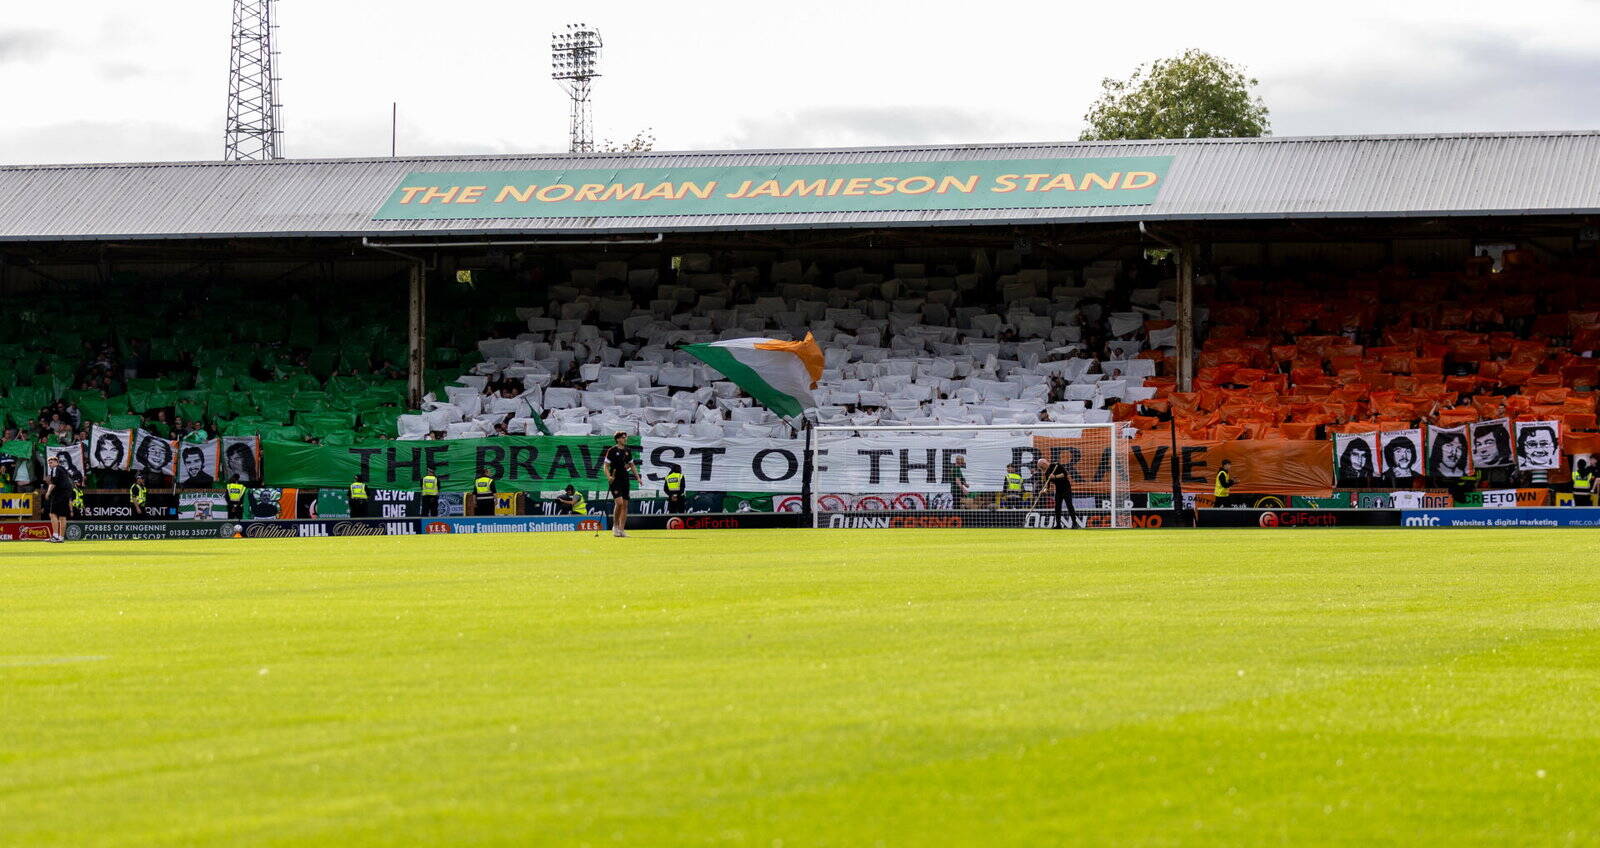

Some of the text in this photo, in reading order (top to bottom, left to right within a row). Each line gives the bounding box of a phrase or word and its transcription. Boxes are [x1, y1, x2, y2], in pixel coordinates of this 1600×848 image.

[400, 171, 1159, 204] THE NORMAN JAMIESON STAND
[348, 445, 450, 482] THE
[857, 448, 967, 484] THE
[1011, 446, 1208, 483] BRAVE
[374, 489, 415, 501] SEVEN
[93, 506, 132, 517] SIMPSO
[145, 507, 168, 517] RINT
[382, 504, 407, 518] ONE
[686, 518, 739, 529] CalForth
[1280, 512, 1336, 526] CalForth
[1452, 518, 1485, 527] Websites
[1494, 517, 1519, 528] digital
[1519, 518, 1558, 528] marketing
[85, 524, 167, 532] FORBES OF KINGENNIE
[169, 528, 217, 537] 01382 350777
[246, 522, 329, 537] William HILL
[333, 521, 417, 537] William HILL
[453, 521, 575, 534] Your Equipment Solutions
